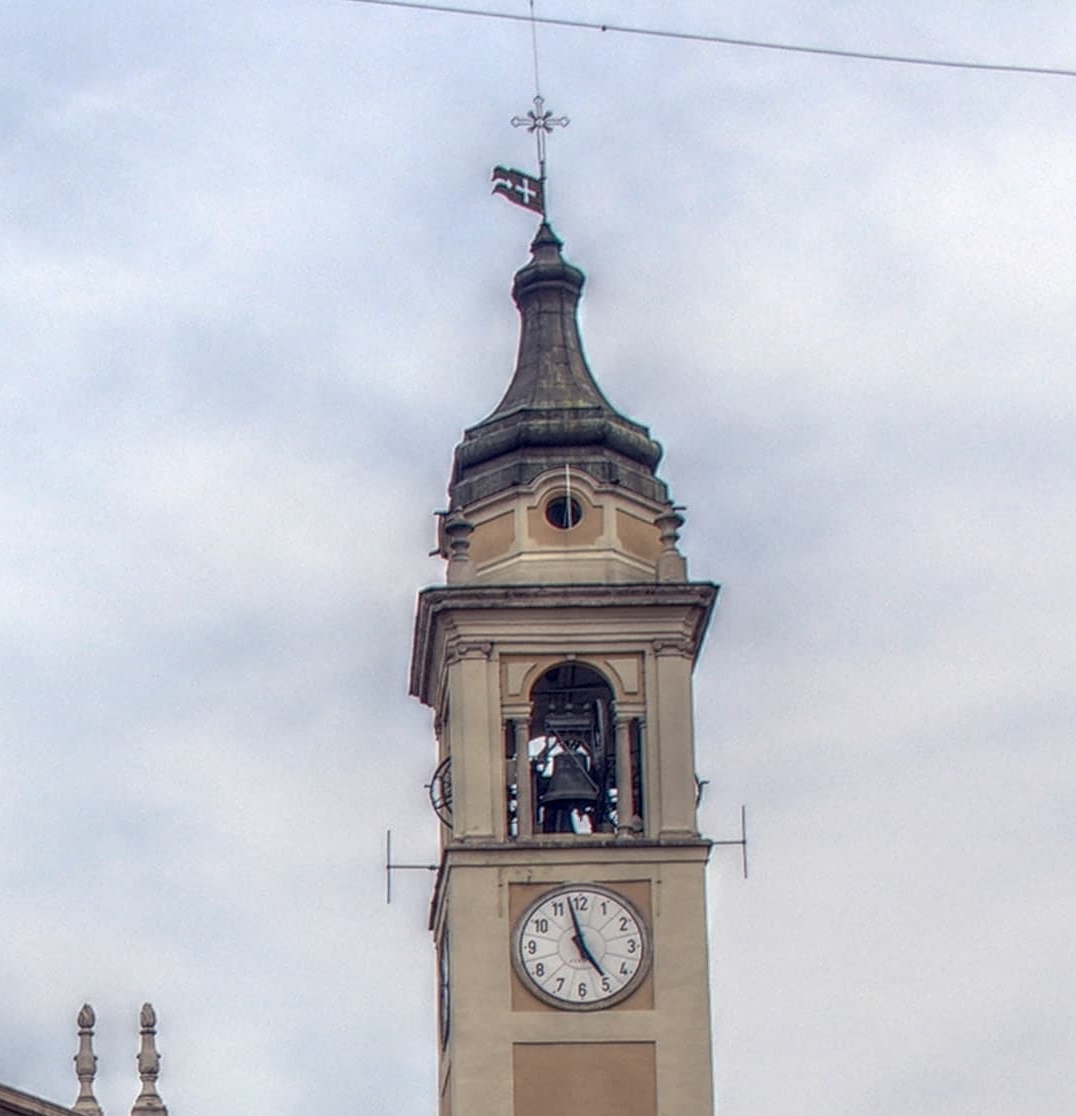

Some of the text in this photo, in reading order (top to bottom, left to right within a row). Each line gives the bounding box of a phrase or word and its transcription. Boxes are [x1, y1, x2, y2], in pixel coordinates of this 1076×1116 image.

[552, 903, 564, 917] 11
[574, 897, 588, 911] 12
[601, 902, 607, 915] 1
[534, 919, 549, 933] 10
[619, 917, 628, 931] 2
[527, 940, 537, 955] 9
[627, 939, 636, 953] 3
[535, 962, 545, 977] 8
[619, 961, 628, 975] 4
[556, 978, 565, 992] 7
[578, 983, 587, 997] 6
[601, 977, 610, 991] 5
